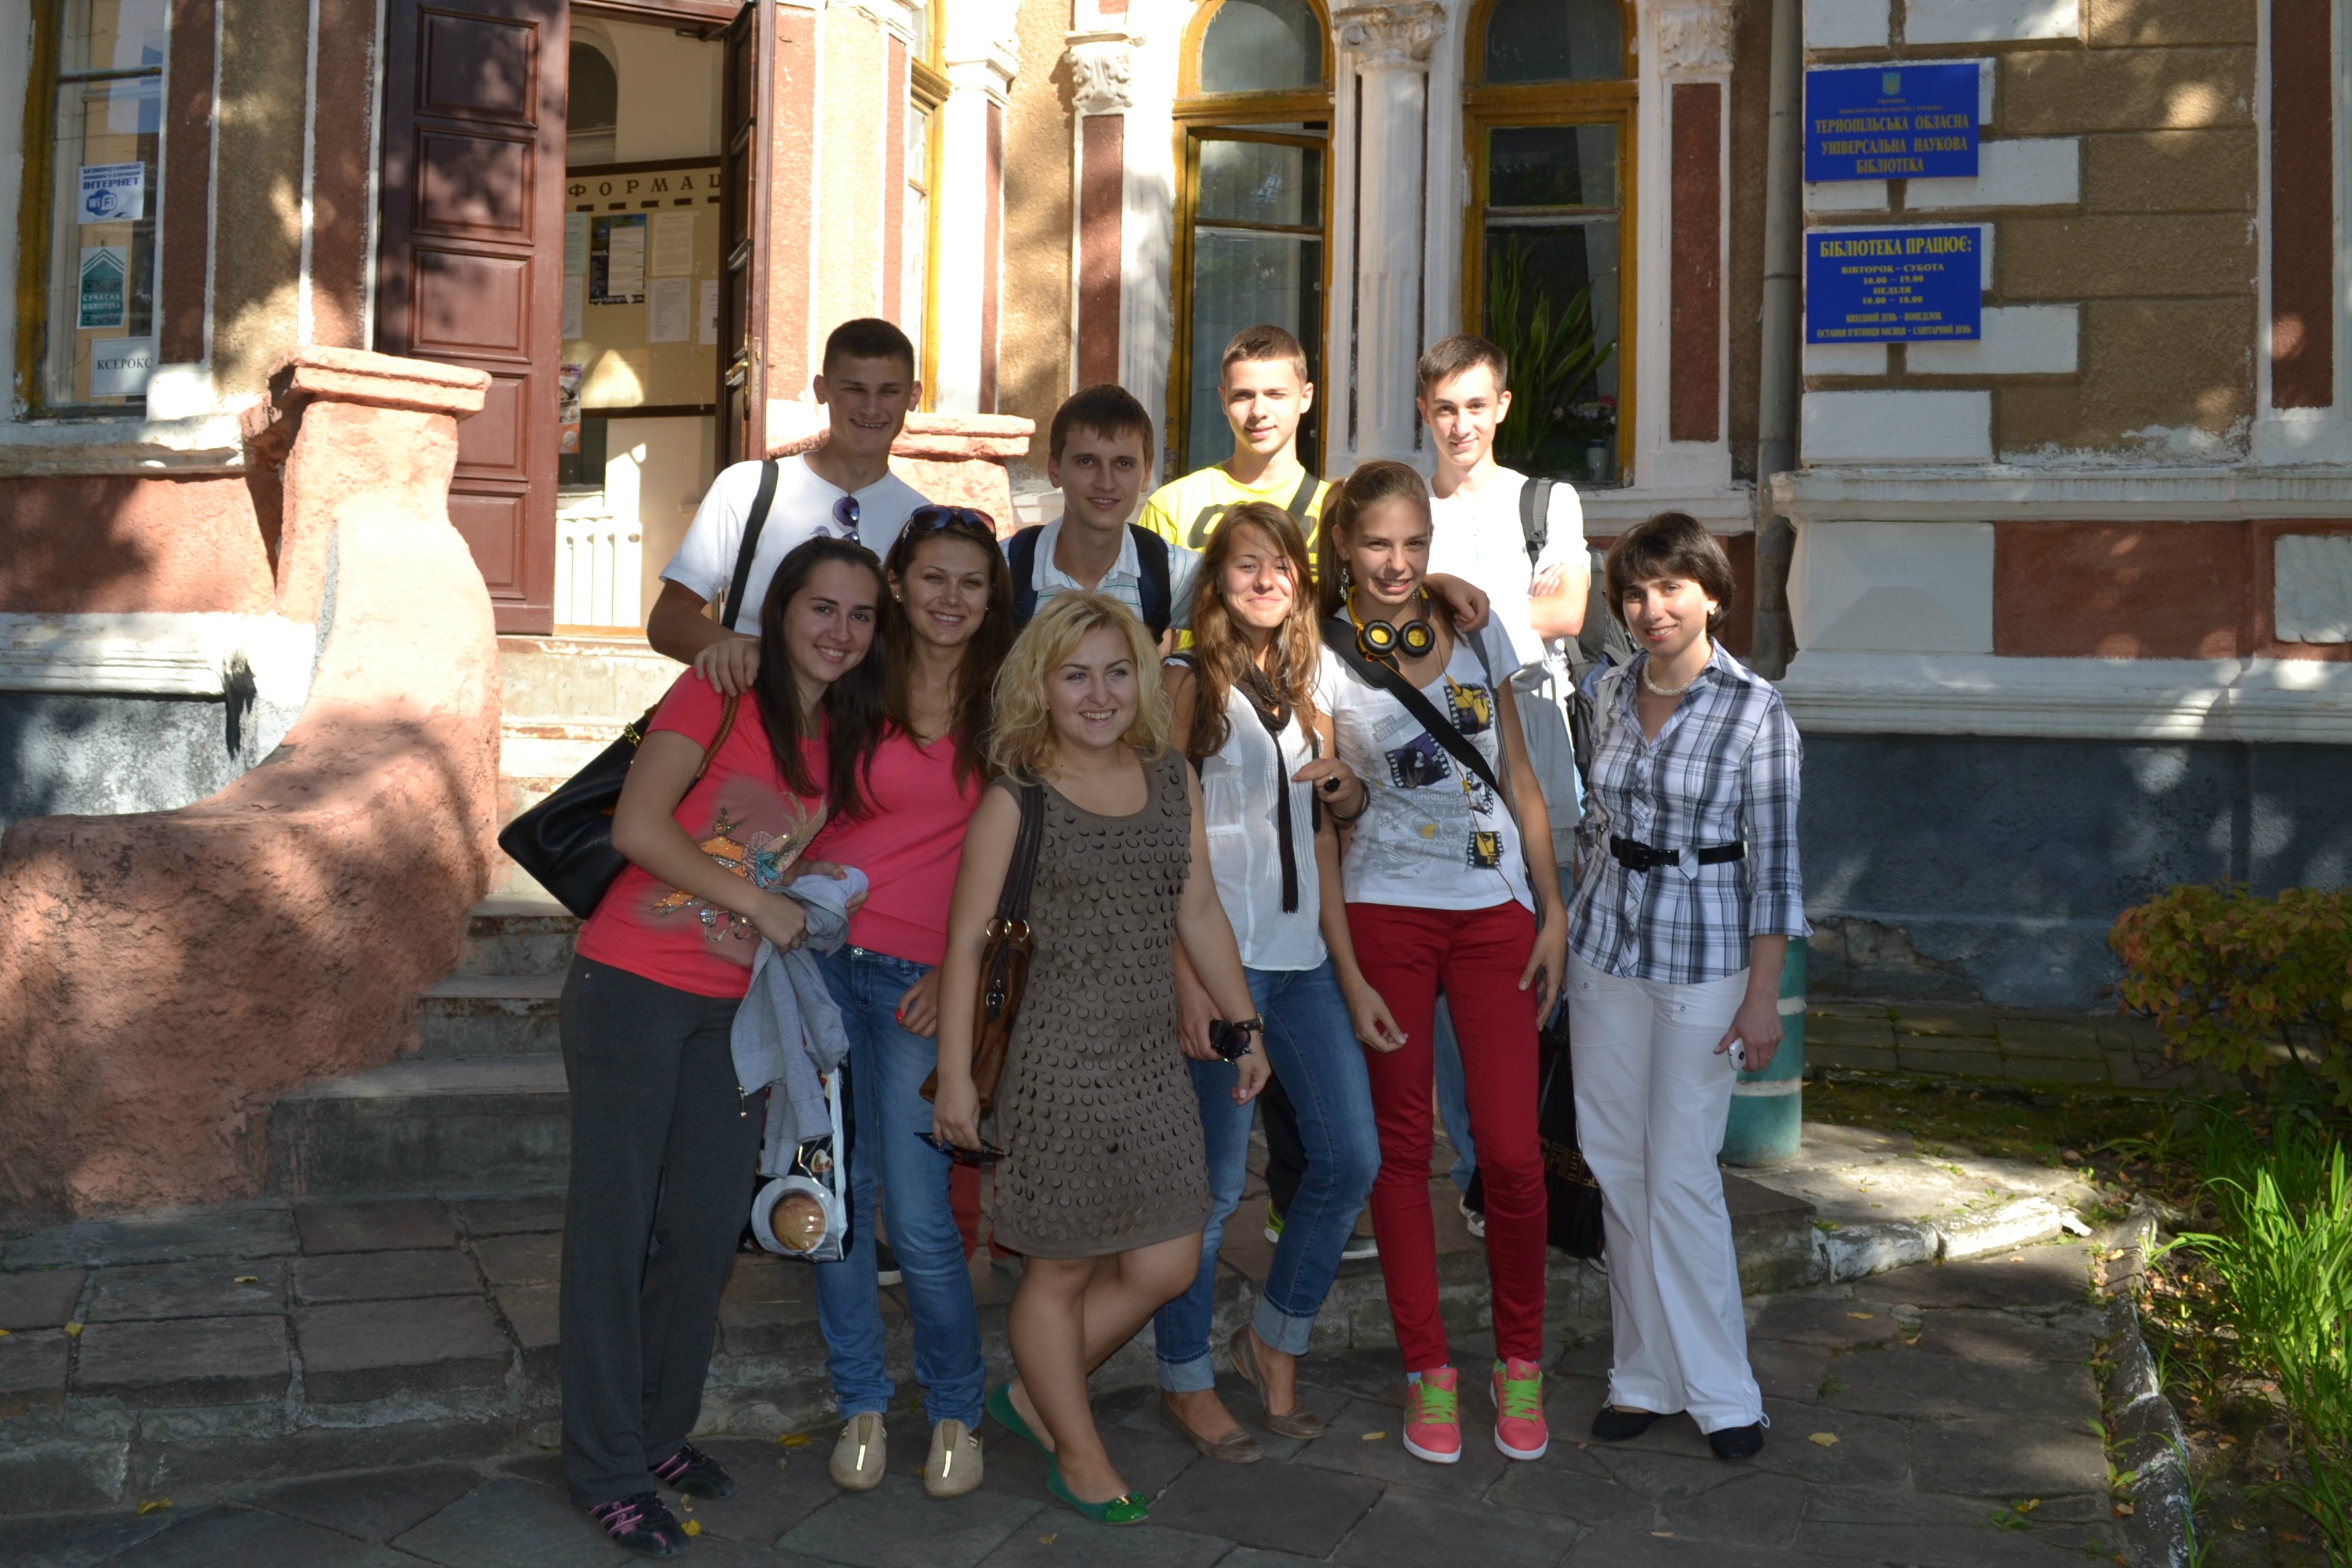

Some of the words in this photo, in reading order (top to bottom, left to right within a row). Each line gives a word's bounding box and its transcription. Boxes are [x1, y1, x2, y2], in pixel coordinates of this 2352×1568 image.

[1815, 116, 1909, 134] ТЕРНОПІЛЬСЬКА
[1915, 114, 1969, 129] ОБЛАСНА
[1822, 139, 1905, 155] УНІВЕРСАЛЬНА
[1914, 137, 1968, 152] НАУКОВА
[1856, 158, 1924, 174] БІБЛІОТЕКА
[83, 177, 139, 190] ІНТЕРНЕТ
[1821, 240, 1902, 257] БІБЛІОТЕКА
[1907, 236, 1971, 254] ПРАЦЮЄ:
[1841, 265, 1894, 275] ВІВТОРОК
[1904, 264, 1944, 272] СУБОТА
[1864, 277, 1887, 285] 10.00
[1873, 286, 1911, 294] НЕДІЛЯ
[83, 293, 120, 302] СУЧАСНА
[97, 358, 153, 370] КСЕРОКС
[1376, 716, 1394, 730] cool
